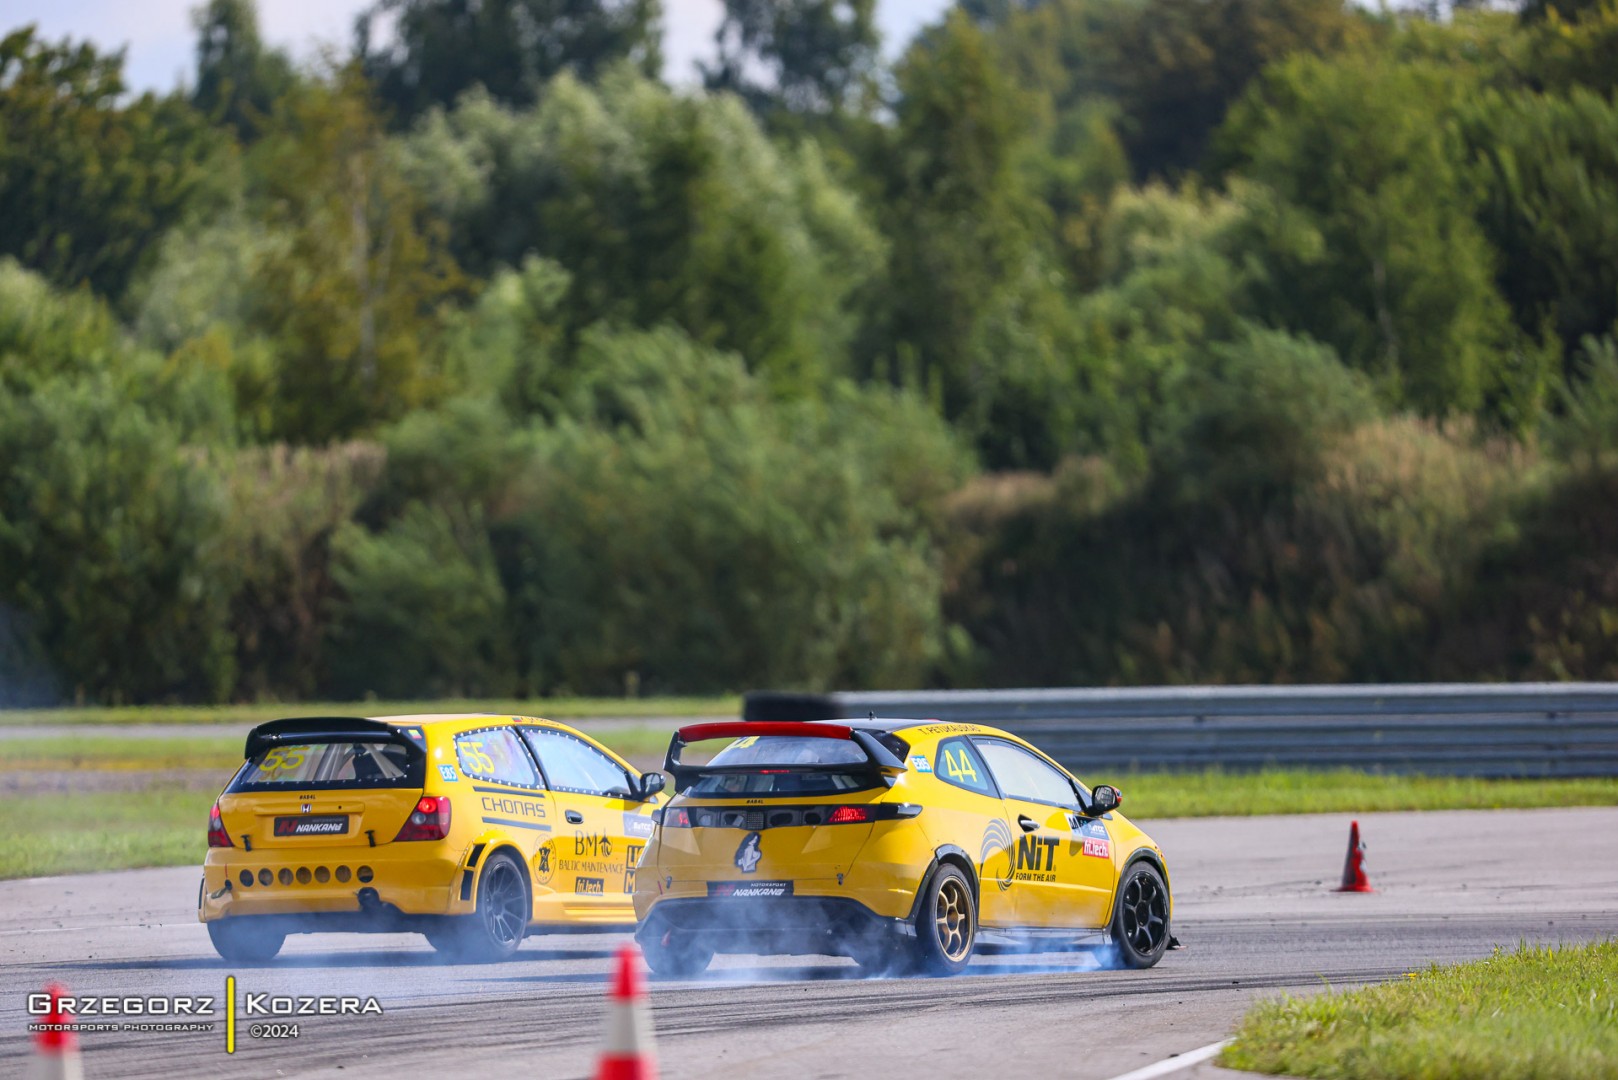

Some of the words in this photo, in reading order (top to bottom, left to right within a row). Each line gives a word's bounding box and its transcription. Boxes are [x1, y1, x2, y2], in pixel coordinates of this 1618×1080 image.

[258, 745, 310, 771] 55
[457, 742, 494, 774] 55
[944, 749, 977, 783] 44
[481, 797, 546, 818] CHONAS
[296, 823, 343, 832] NANKANG
[1016, 872, 1032, 881] FORM
[1033, 873, 1045, 882] THE
[1045, 874, 1057, 882] AIR
[733, 888, 785, 896] NANKANG
